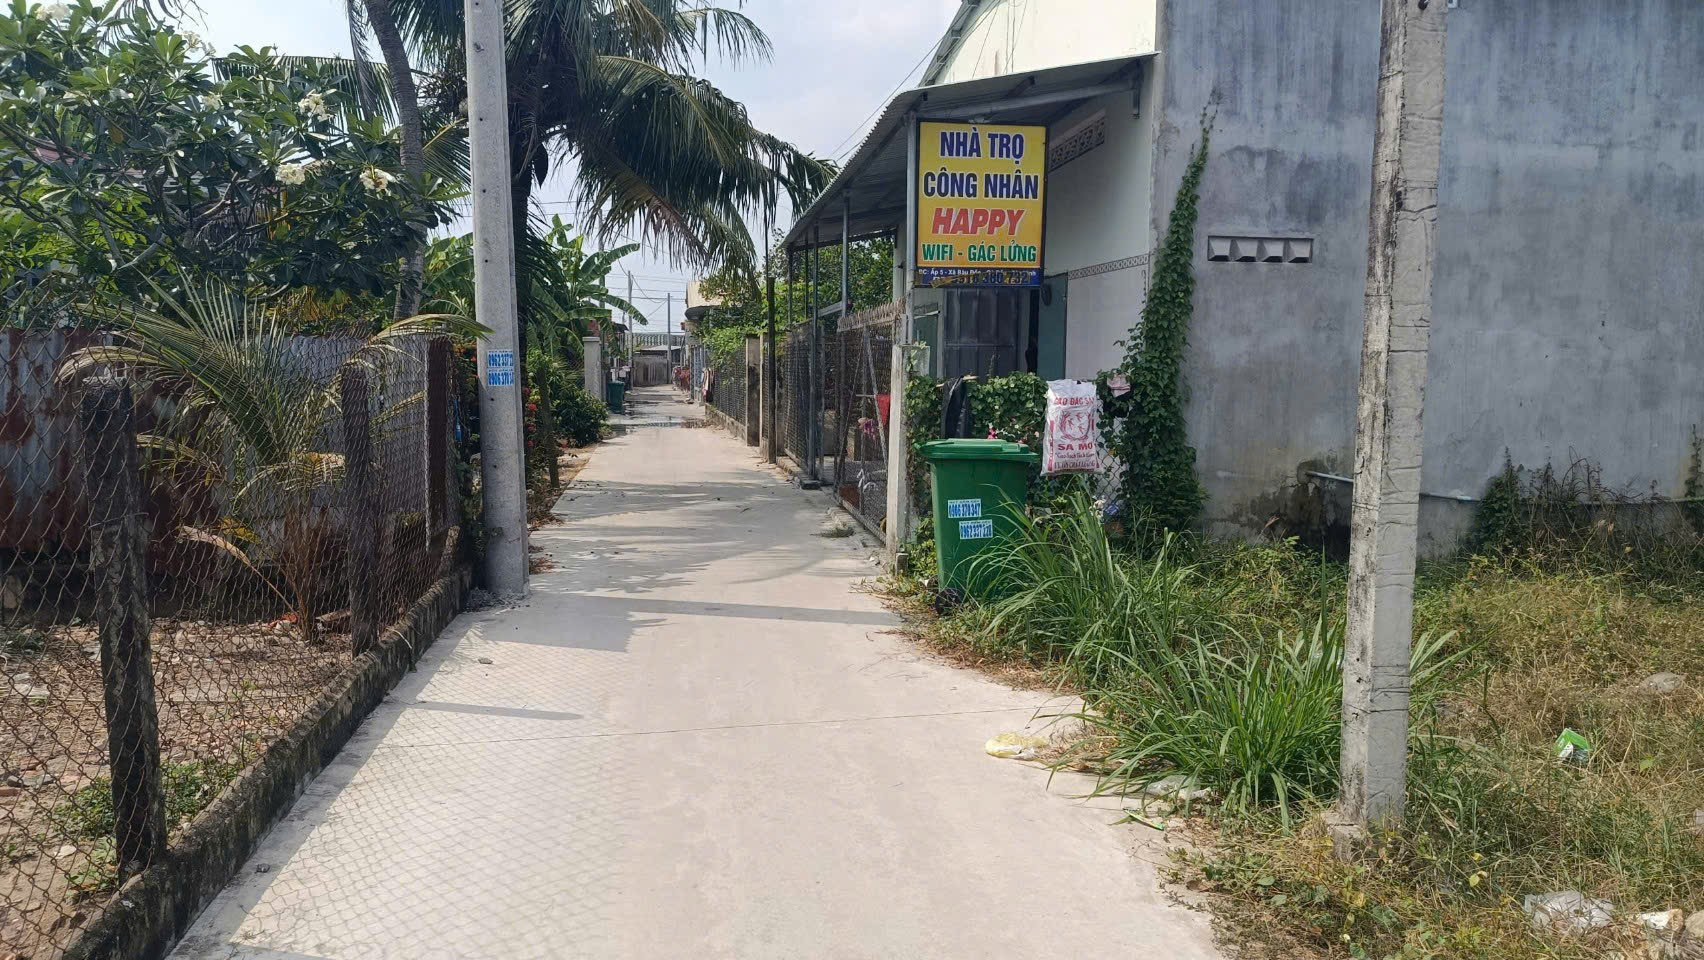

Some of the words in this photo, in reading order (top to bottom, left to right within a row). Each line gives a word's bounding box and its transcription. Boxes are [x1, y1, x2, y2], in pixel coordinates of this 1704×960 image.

[940, 127, 981, 158] NHÀ
[988, 132, 1024, 164] TRỌ
[923, 167, 977, 198] CÔNG
[984, 169, 1038, 200] NHÂN
[932, 207, 1024, 236] HAPPY
[921, 243, 954, 261] WIFI
[967, 241, 996, 262] GÁC
[1000, 240, 1037, 263] LỬNG
[1057, 443, 1074, 451] SA
